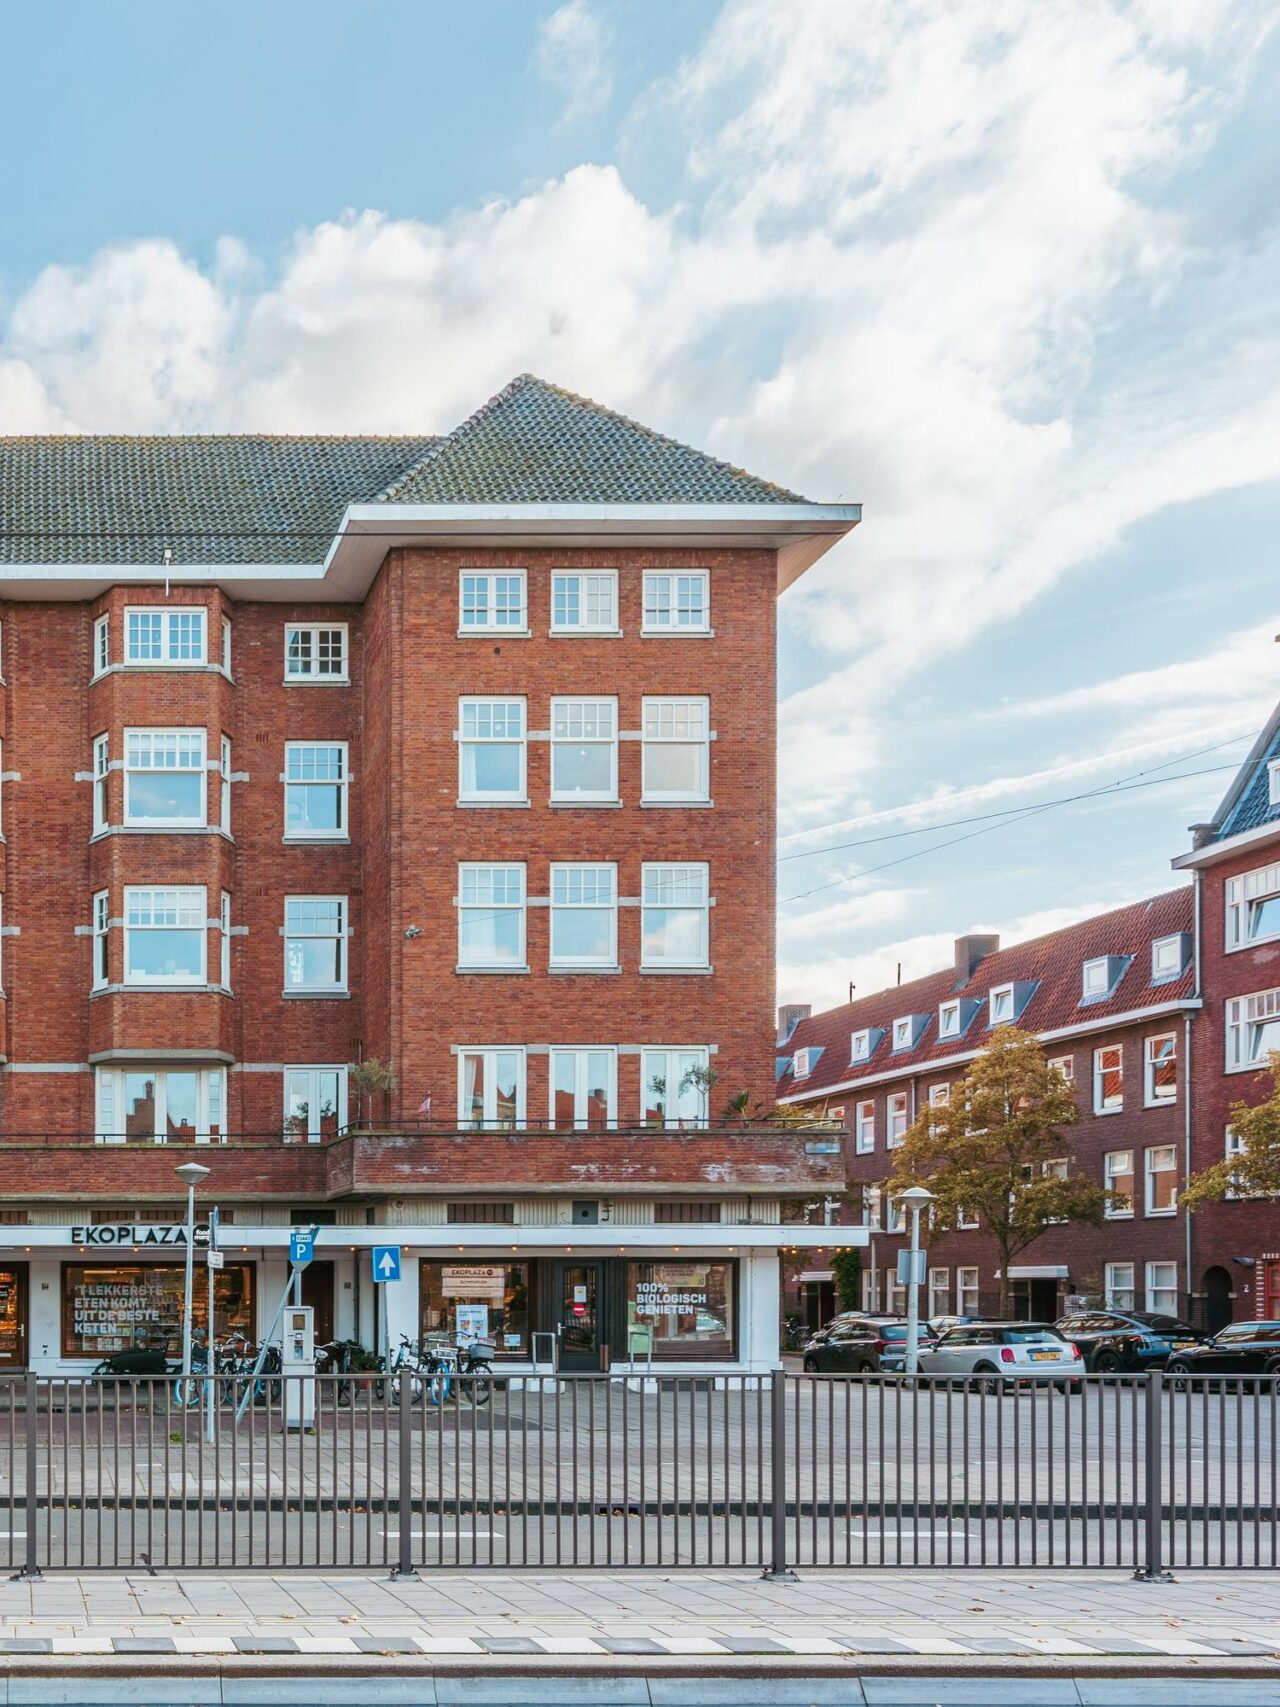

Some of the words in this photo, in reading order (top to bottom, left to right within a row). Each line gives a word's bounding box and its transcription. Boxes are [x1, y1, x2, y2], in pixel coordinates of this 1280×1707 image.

[71, 1227, 189, 1244] EKOPLAZA
[296, 1244, 307, 1259] P
[88, 1284, 164, 1296] LEKKERSTE
[636, 1282, 669, 1293] 100%
[1243, 1284, 1250, 1293] 2
[74, 1297, 109, 1309] ETEN
[110, 1297, 148, 1309] KOMT
[636, 1293, 707, 1304] BIOLOGISCH
[636, 1304, 694, 1315] GENIETEN
[74, 1310, 96, 1321] UIT
[98, 1310, 117, 1321] DE
[119, 1310, 160, 1321] BESTE
[74, 1322, 118, 1334] KETEN
